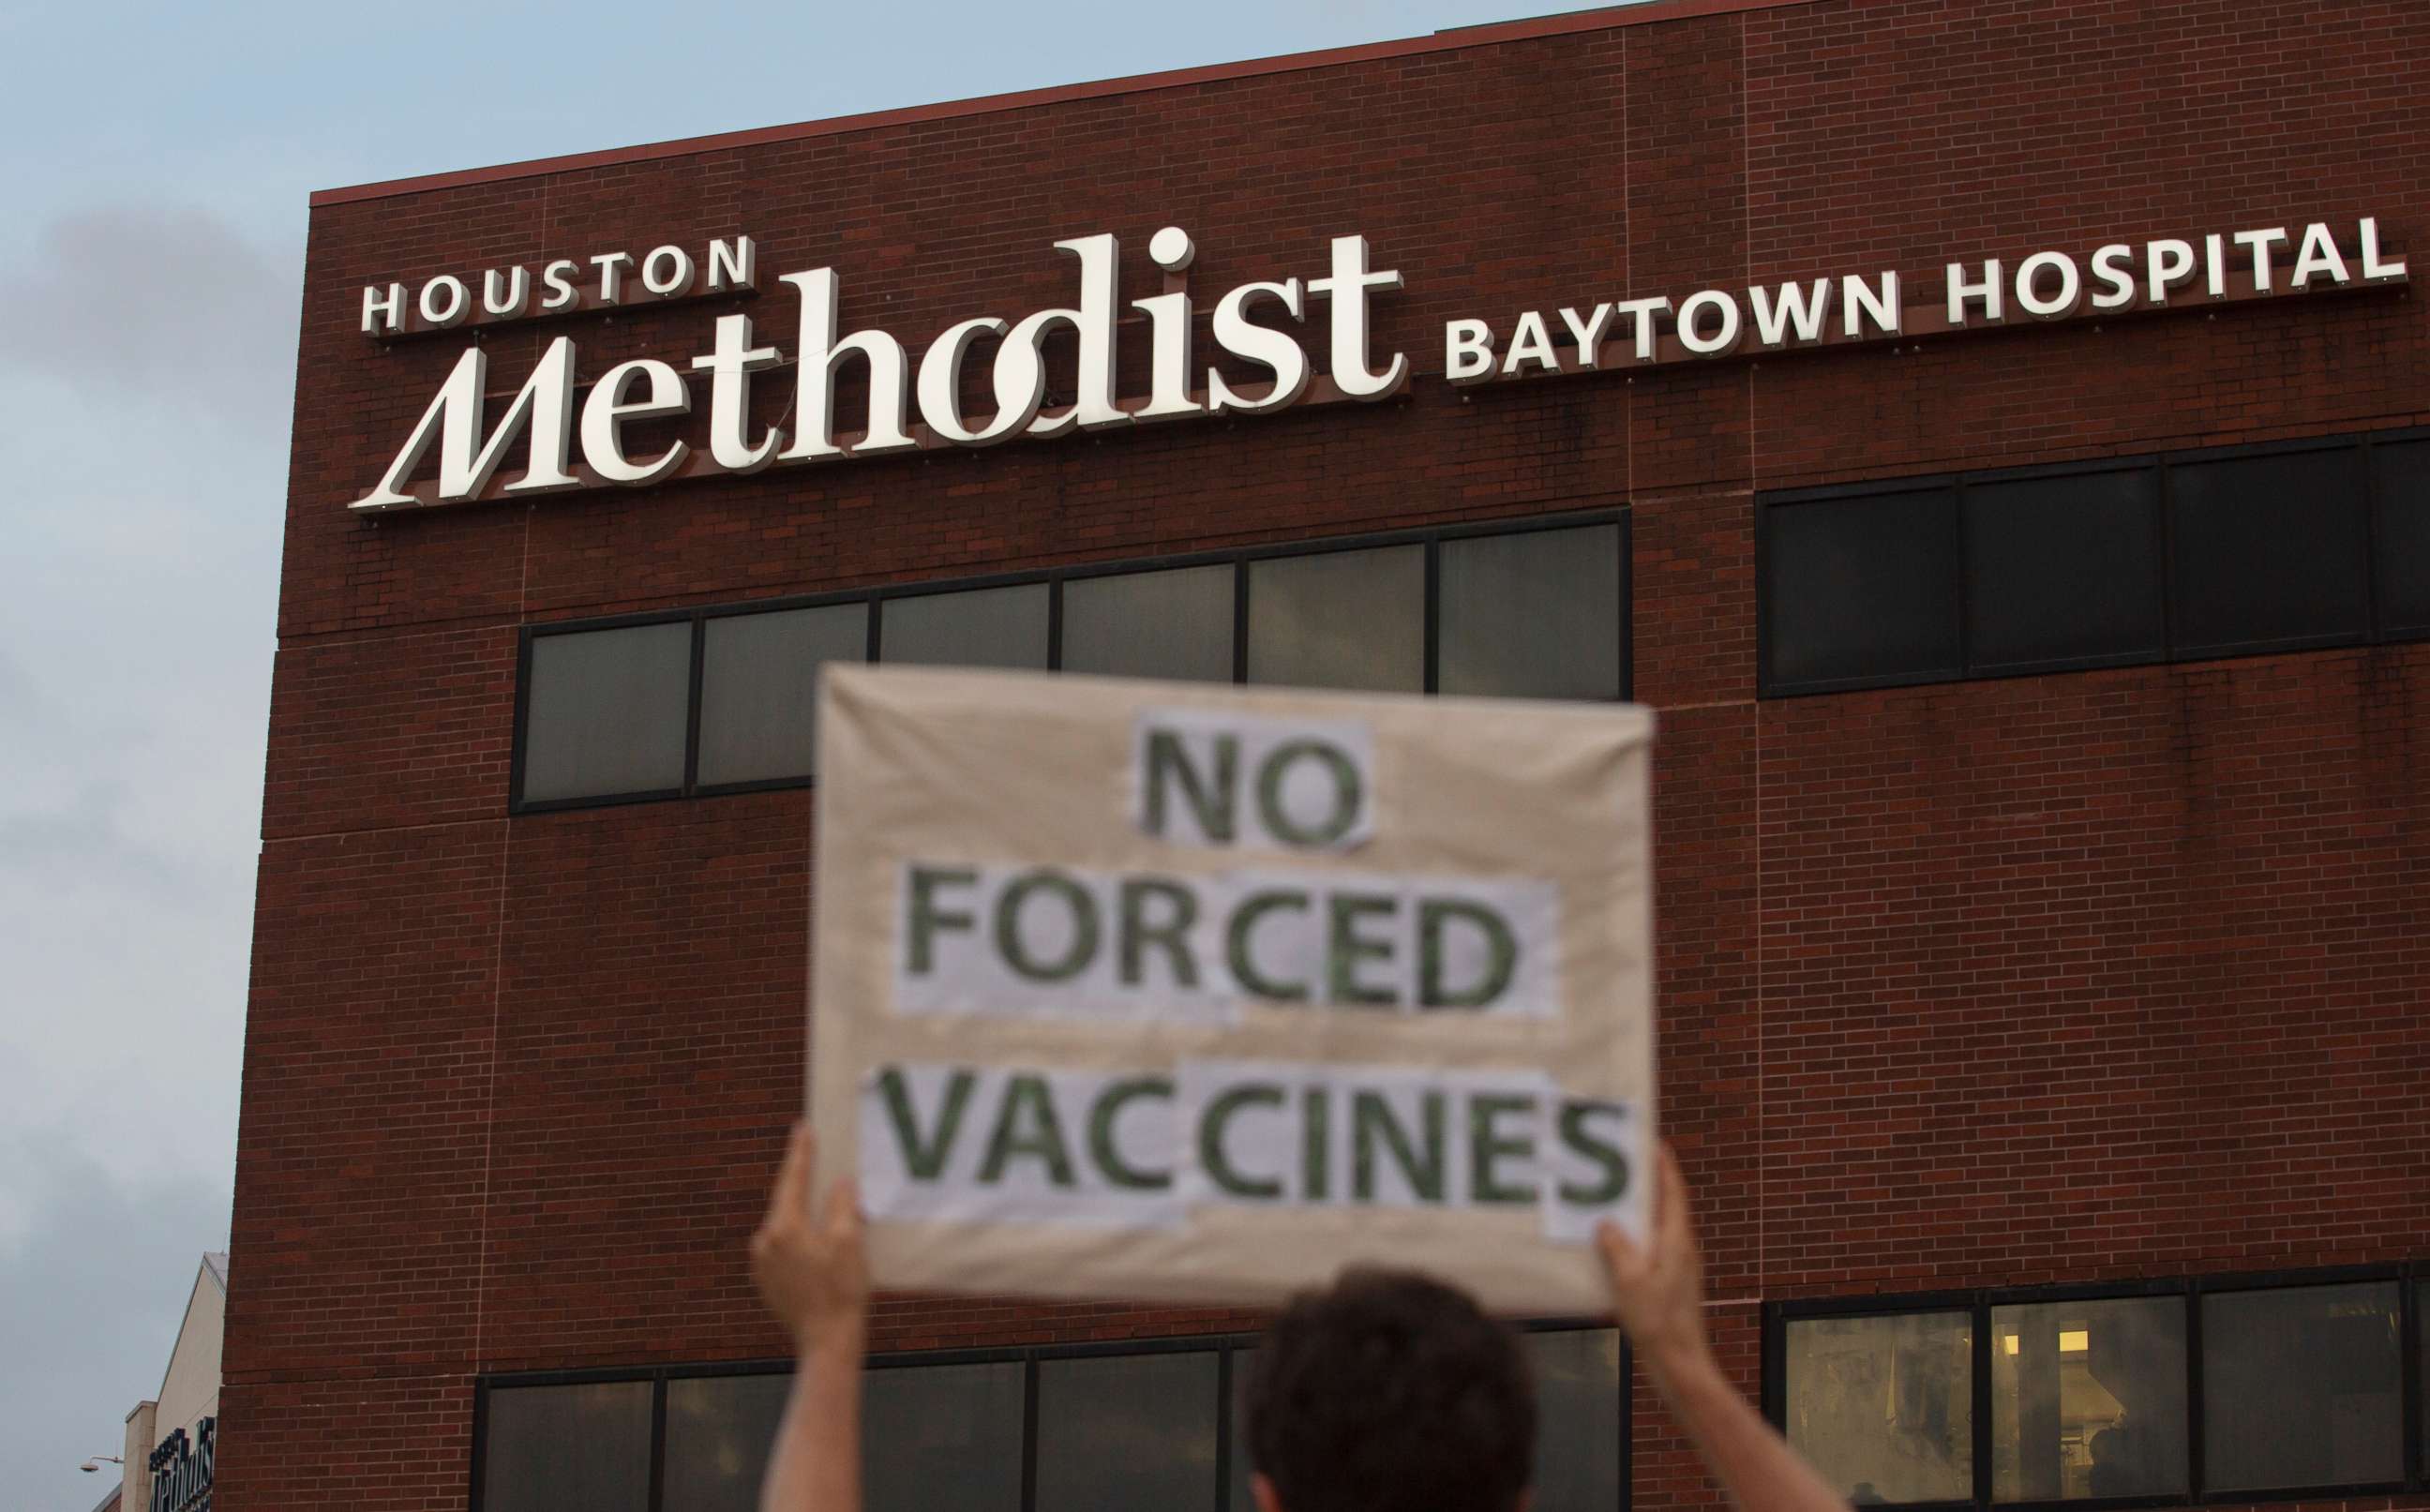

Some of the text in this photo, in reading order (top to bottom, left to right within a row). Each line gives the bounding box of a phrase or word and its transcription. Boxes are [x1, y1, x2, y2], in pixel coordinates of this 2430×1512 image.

[361, 236, 752, 334] HOUSTON
[1446, 217, 2407, 380] BAYTOWN HOSPITAL
[348, 227, 1404, 510] Methodist
[1144, 730, 1362, 846] NO
[907, 868, 1519, 1009] FORCED
[878, 1068, 1631, 1206] VACCINES
